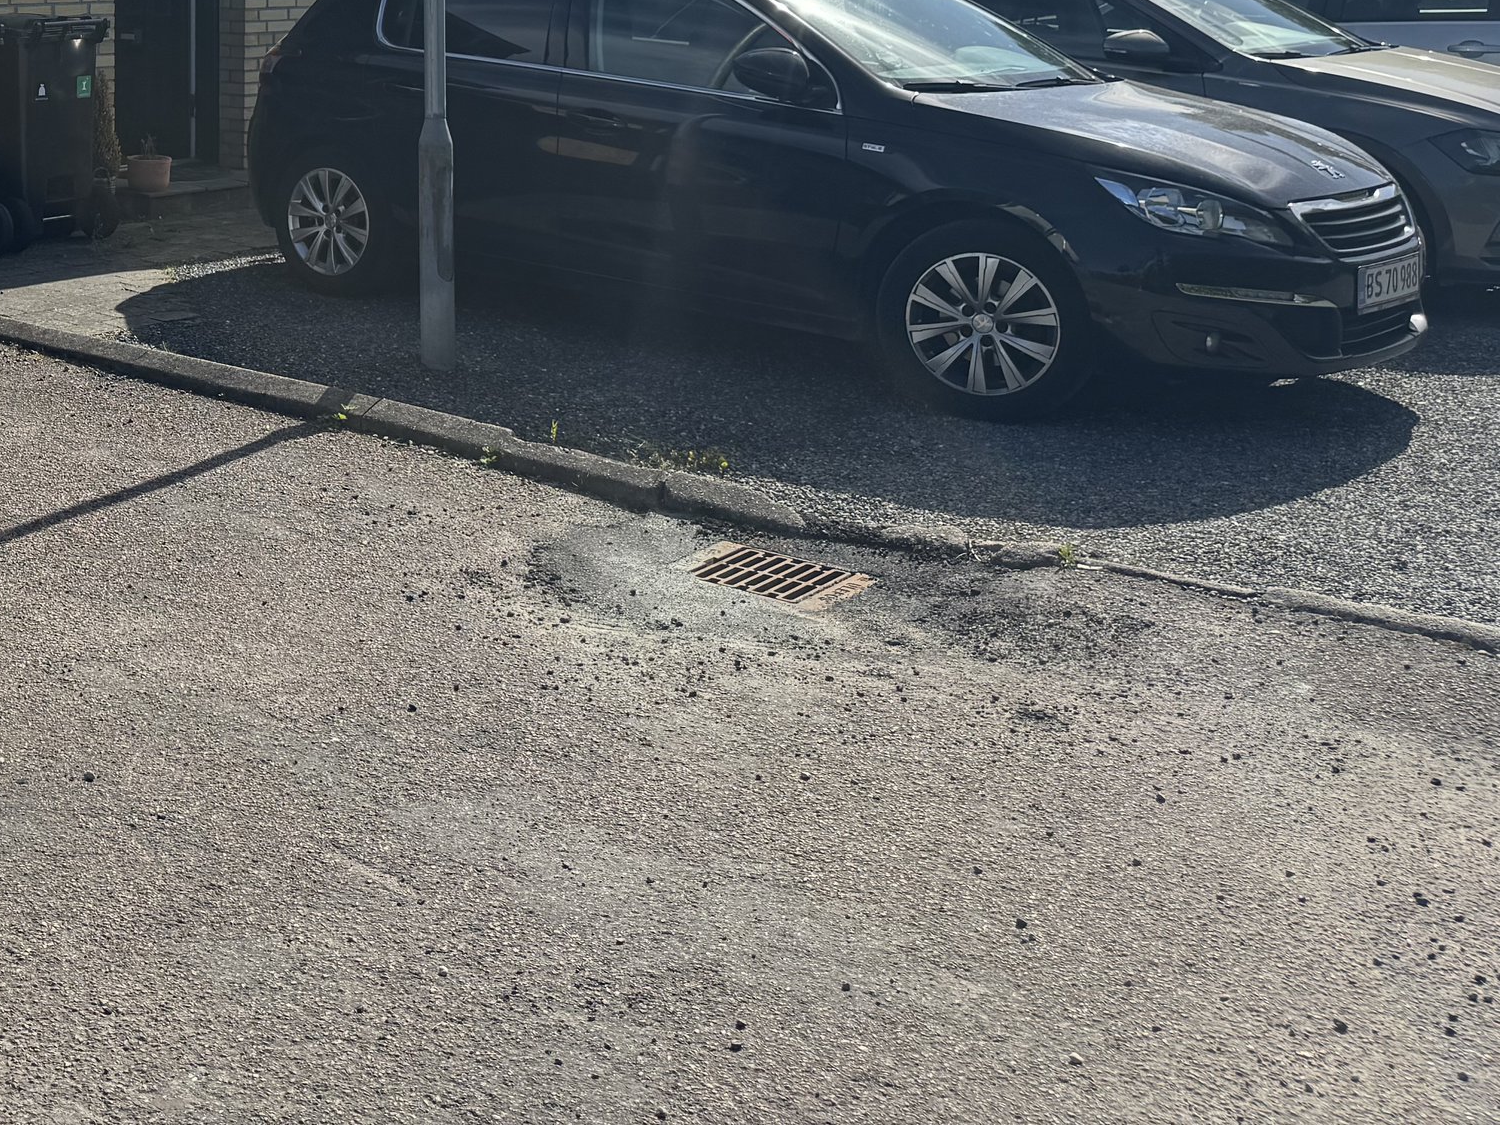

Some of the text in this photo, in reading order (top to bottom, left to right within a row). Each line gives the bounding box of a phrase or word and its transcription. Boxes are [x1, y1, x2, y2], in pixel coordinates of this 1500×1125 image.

[1366, 261, 1418, 299] BS 70 988
